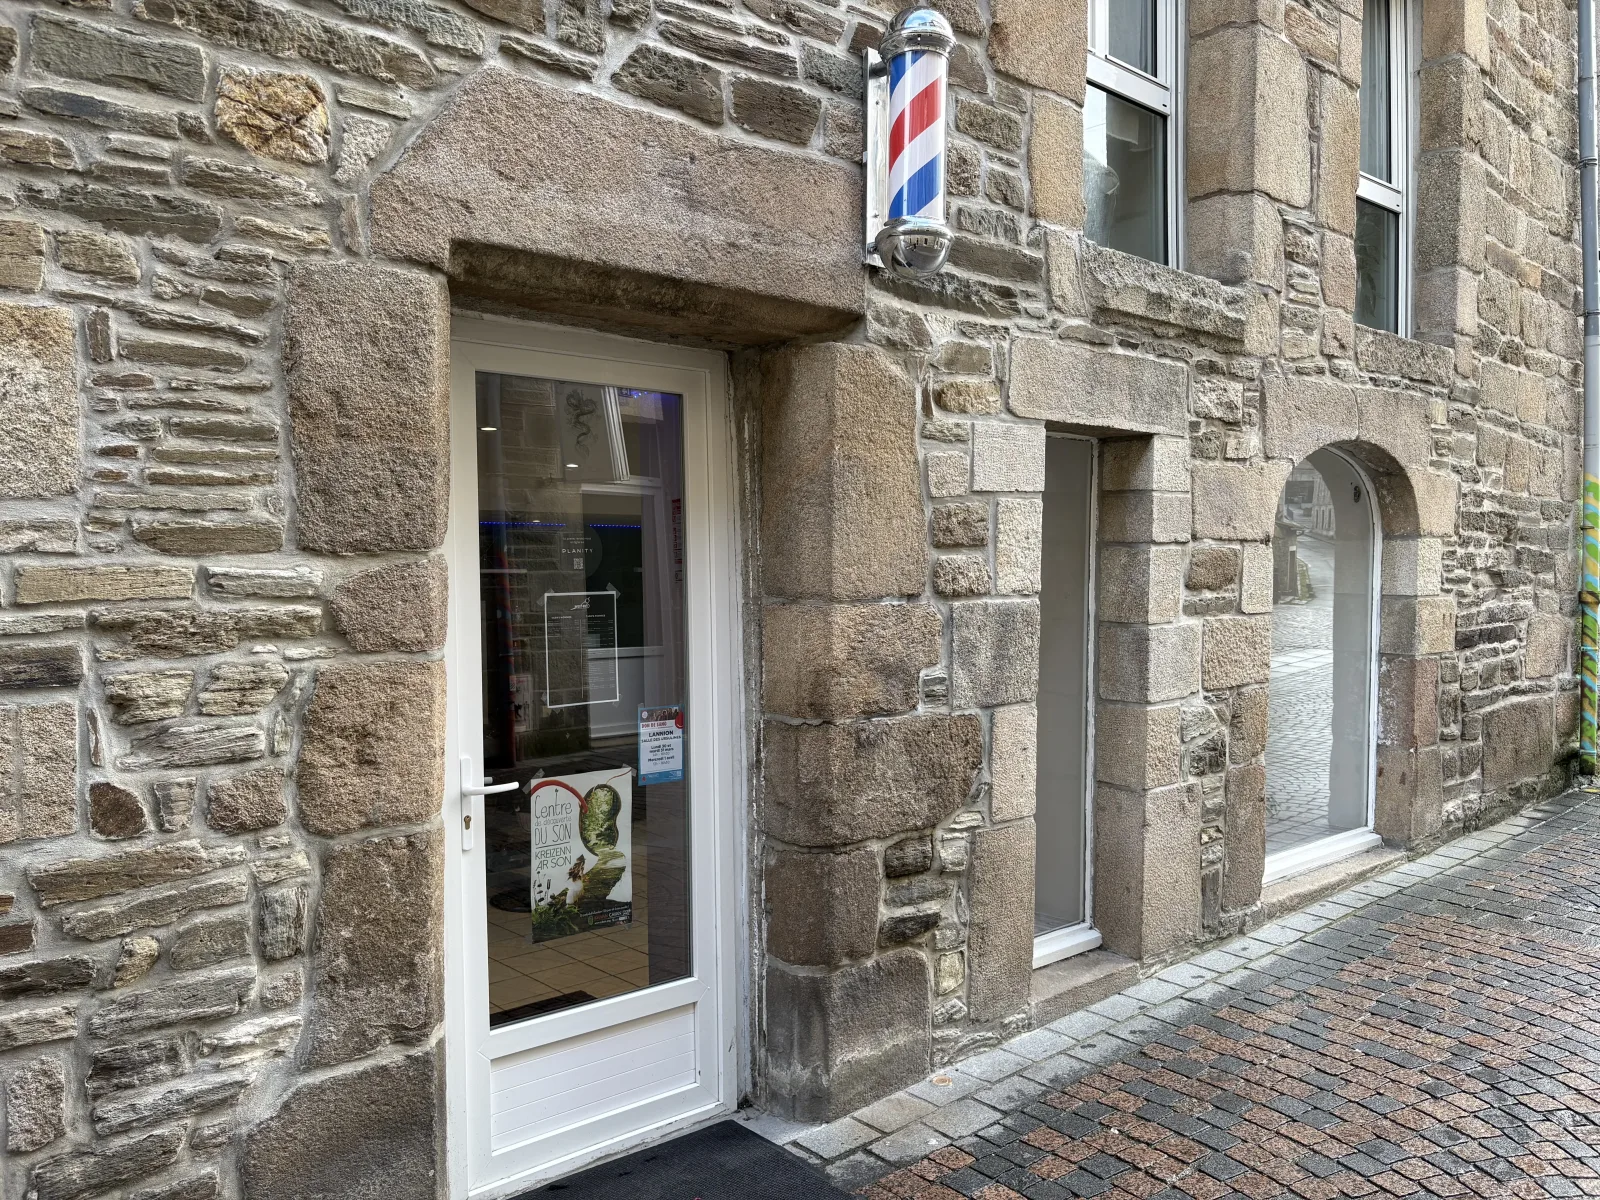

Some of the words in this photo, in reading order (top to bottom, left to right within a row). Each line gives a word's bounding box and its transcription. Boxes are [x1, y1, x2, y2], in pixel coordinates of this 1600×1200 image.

[534, 788, 573, 819] Centre
[534, 826, 548, 846] DU
[552, 823, 572, 843] SON
[535, 845, 572, 861] KREIZENN
[535, 860, 549, 871] AR
[551, 855, 572, 869] SON
